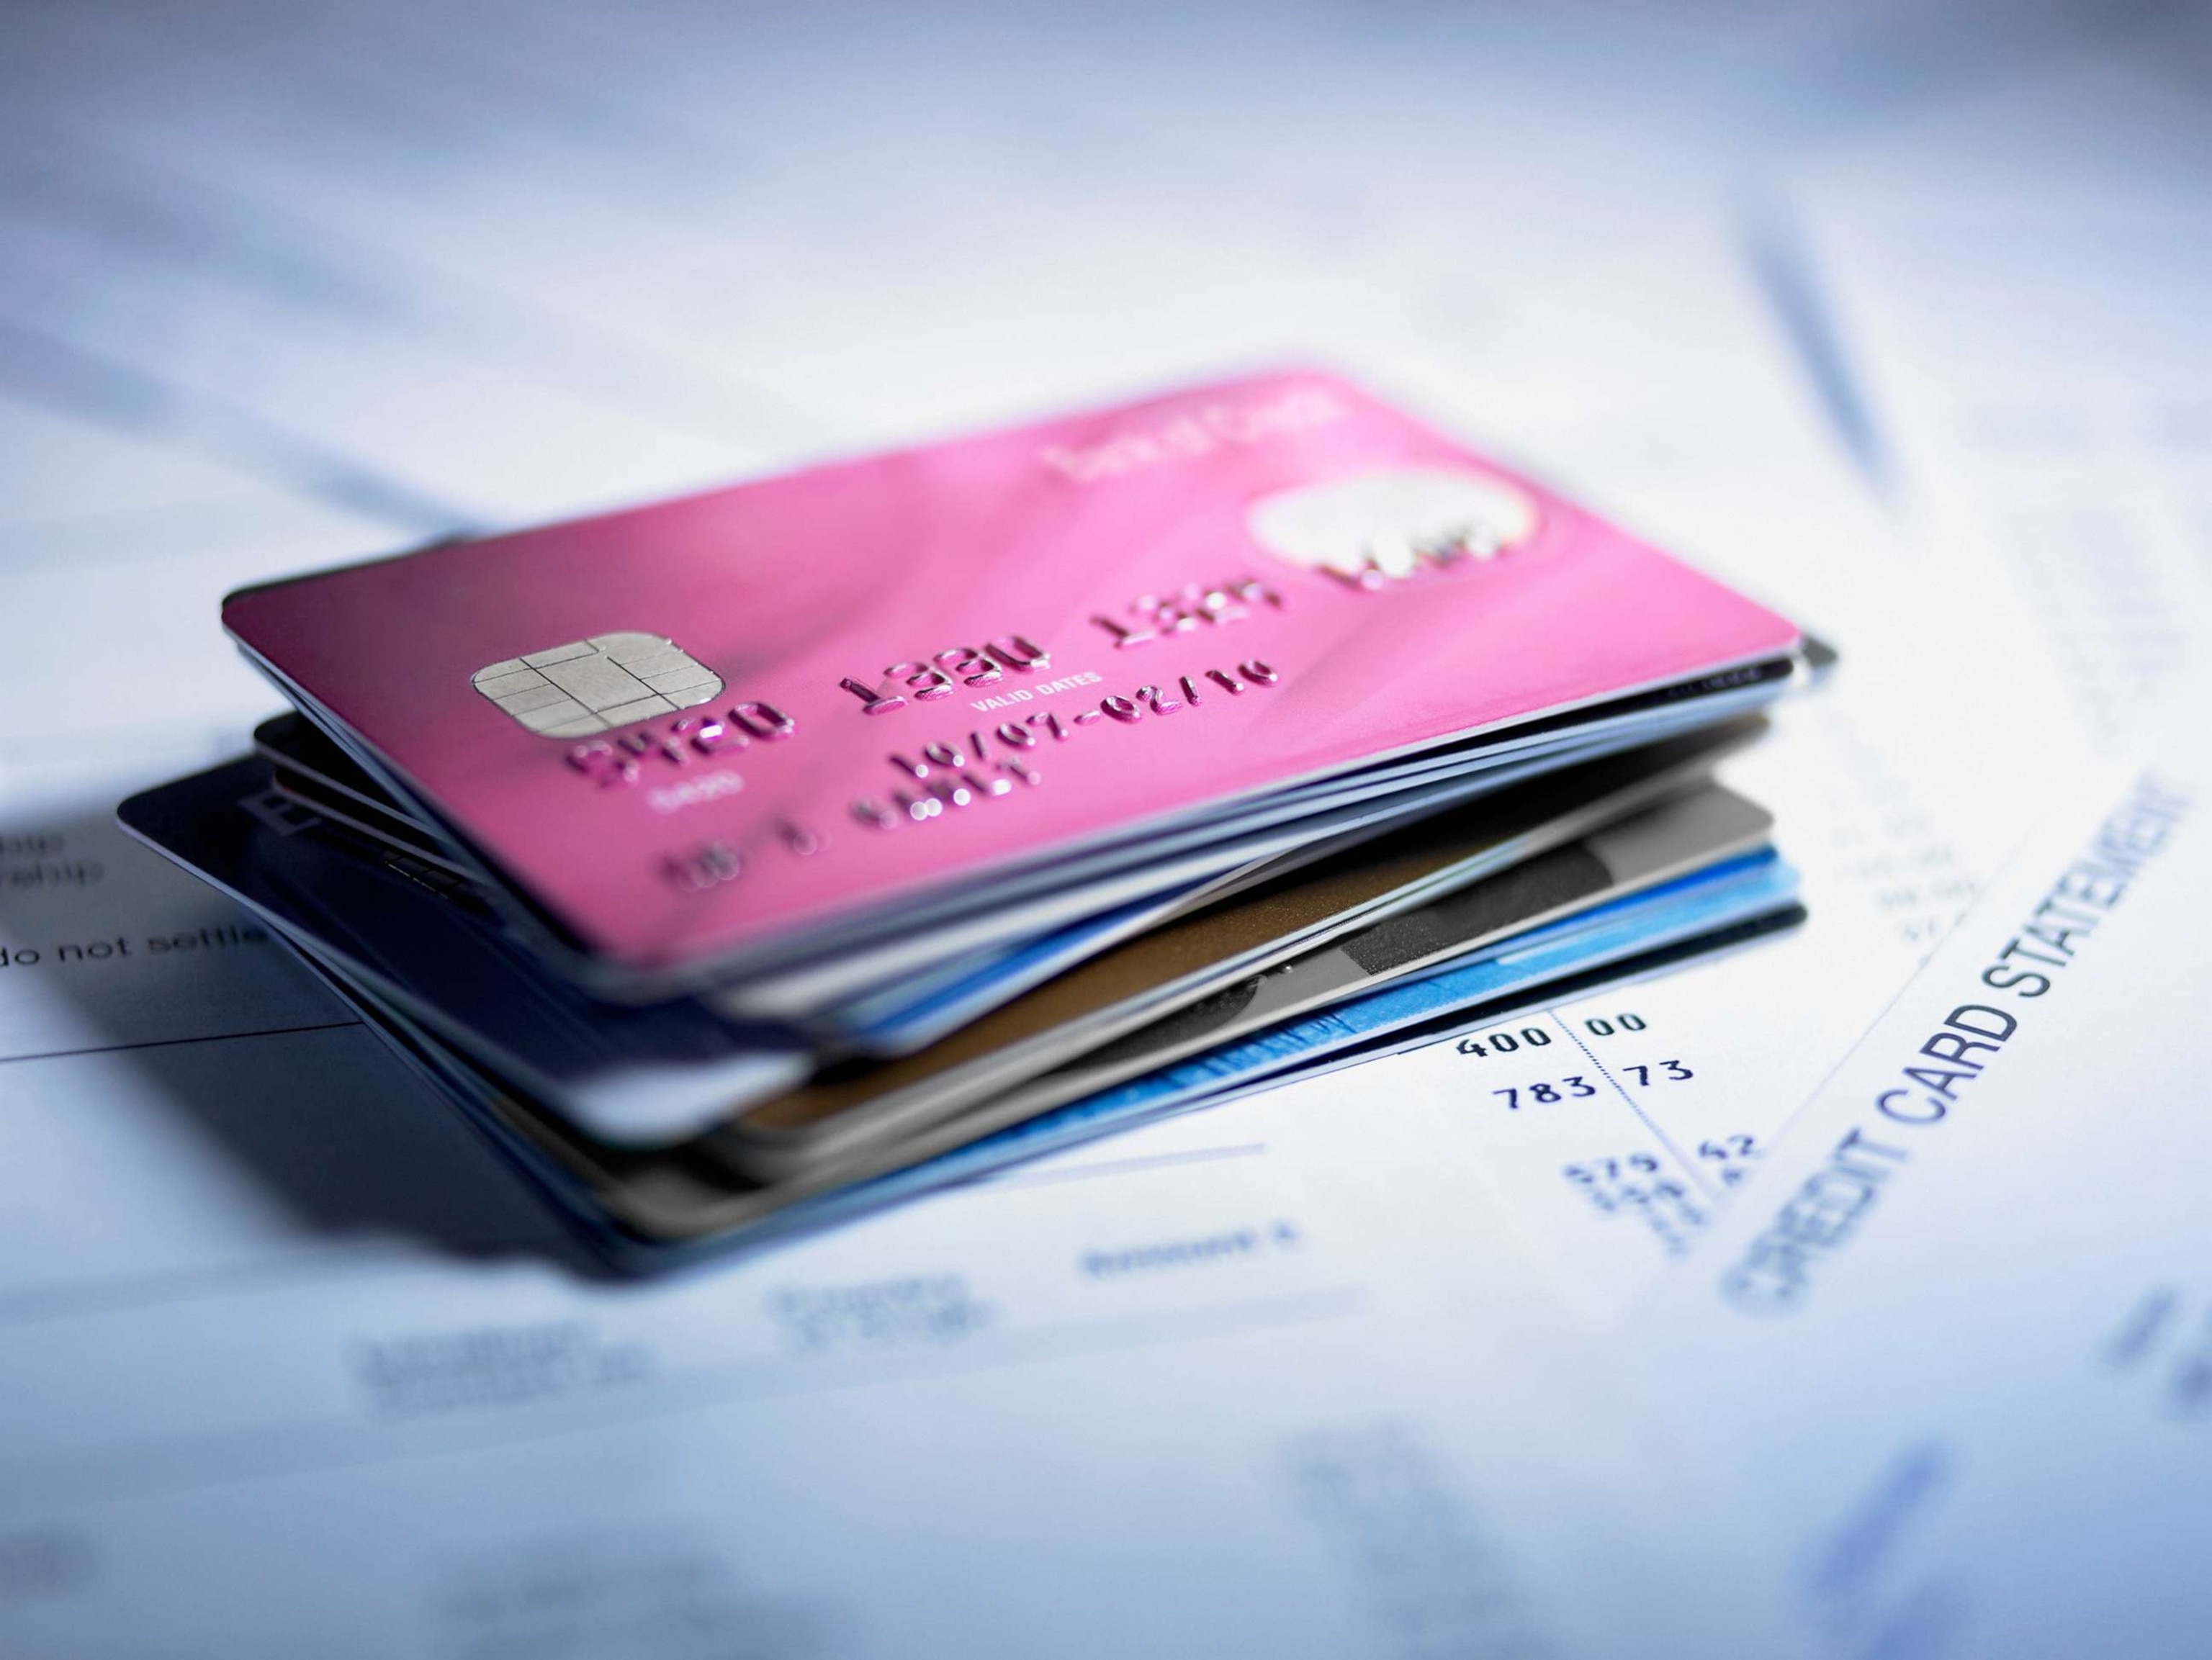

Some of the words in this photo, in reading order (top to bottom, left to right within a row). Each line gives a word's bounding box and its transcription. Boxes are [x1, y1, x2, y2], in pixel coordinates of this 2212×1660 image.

[969, 689, 1035, 713] VALID
[1035, 671, 1104, 696] DATES
[889, 657, 1279, 778] 10/07-02/10
[0, 860, 104, 887] ship
[58, 936, 127, 962] not
[1456, 1027, 1552, 1057] 400
[1585, 1012, 1647, 1037] 00
[1721, 1125, 1912, 1320] CREDIT
[1874, 1003, 2018, 1126] CARD
[1981, 764, 2196, 998] STATEMENT
[1492, 1075, 1596, 1109] 783
[1622, 1060, 1694, 1086] 73
